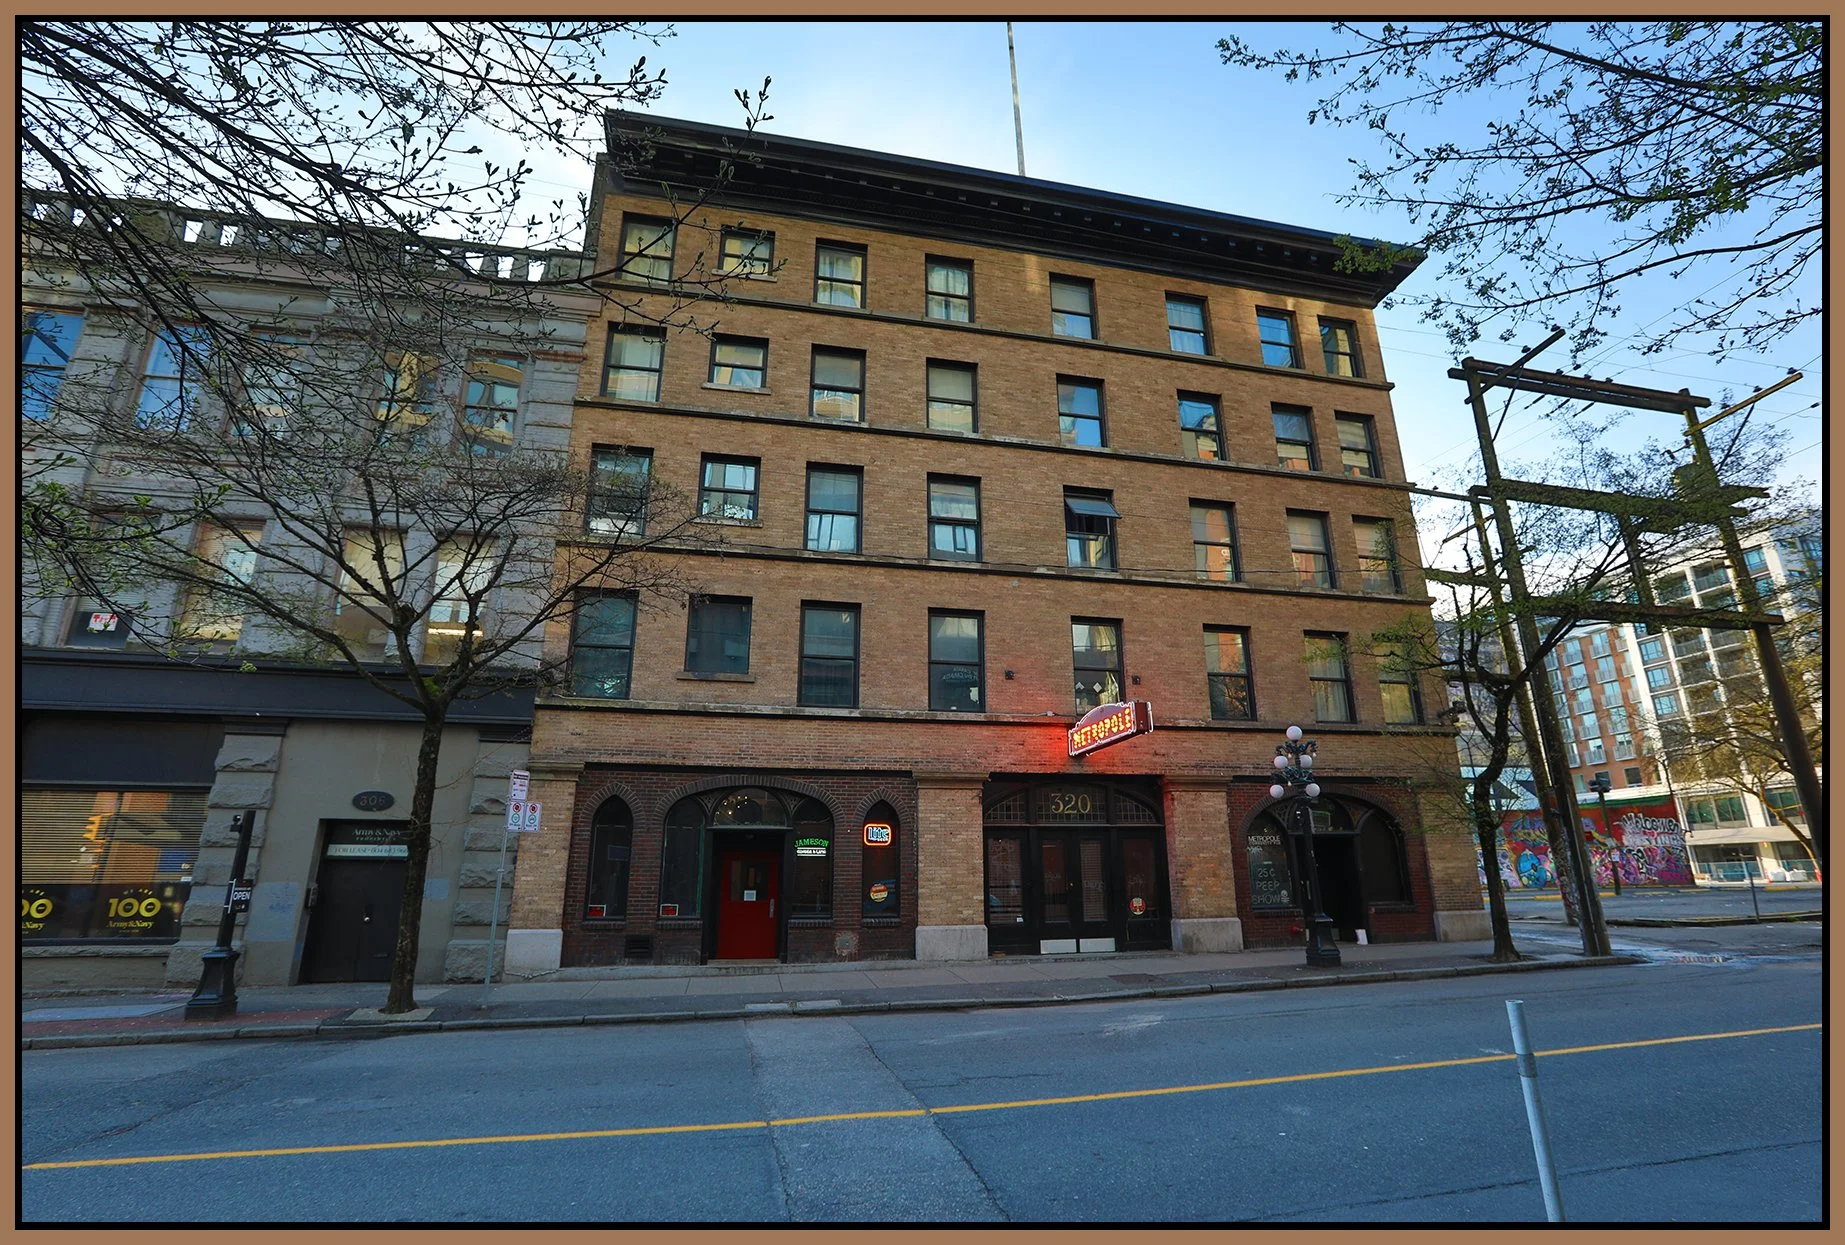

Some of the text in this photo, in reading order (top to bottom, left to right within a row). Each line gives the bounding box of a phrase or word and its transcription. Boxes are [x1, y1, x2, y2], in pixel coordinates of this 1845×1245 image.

[1072, 708, 1132, 749] METROPOLE
[1051, 793, 1091, 814] 320
[794, 838, 829, 847] JAMESON
[1256, 880, 1280, 891] PEEP
[233, 891, 251, 900] OPEN
[108, 897, 161, 918] 100
